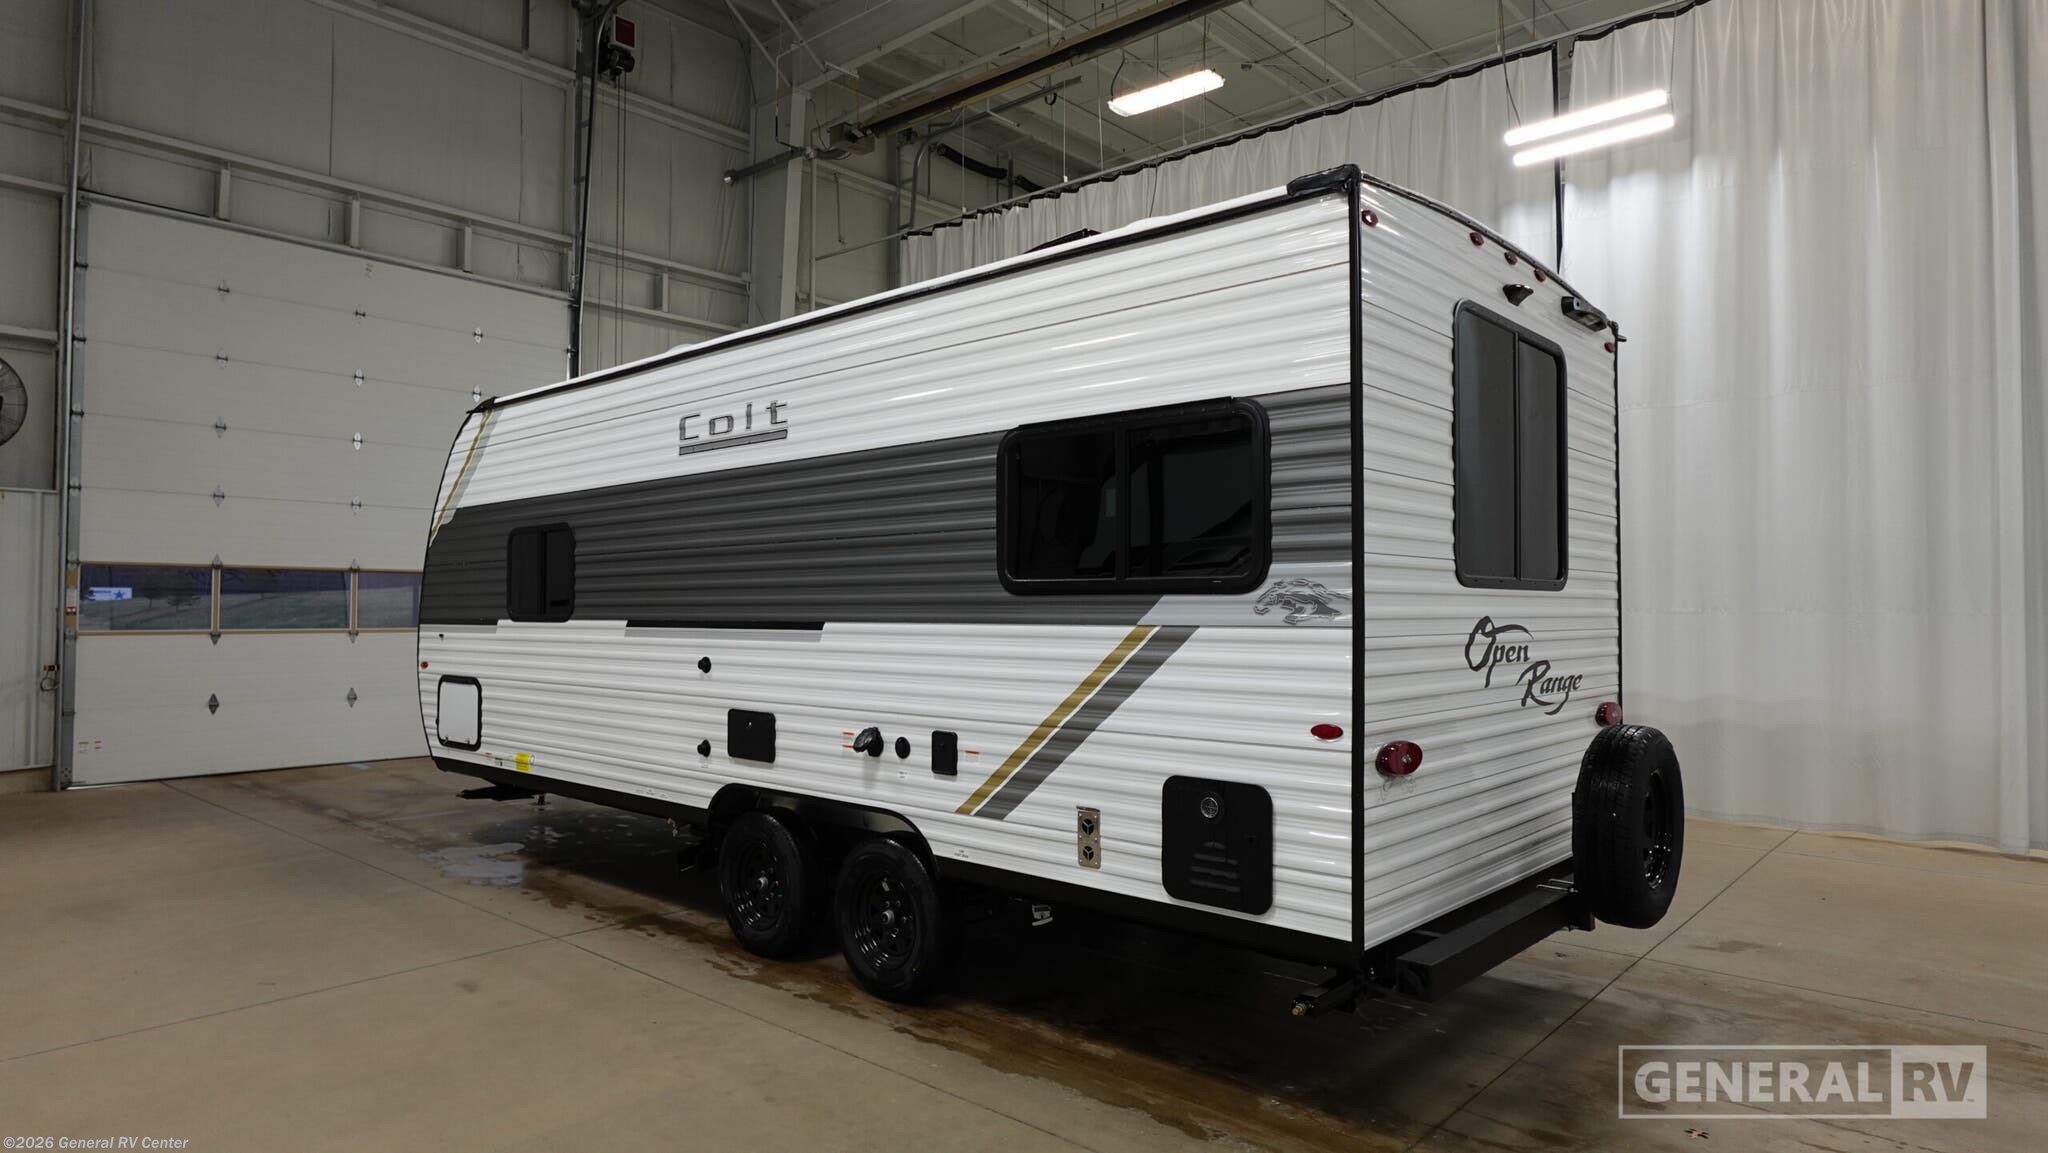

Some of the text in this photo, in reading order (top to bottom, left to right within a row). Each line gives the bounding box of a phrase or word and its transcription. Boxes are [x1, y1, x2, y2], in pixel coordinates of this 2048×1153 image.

[679, 401, 788, 440] Colt
[1464, 615, 1534, 688] Open
[1514, 660, 1583, 715] Range
